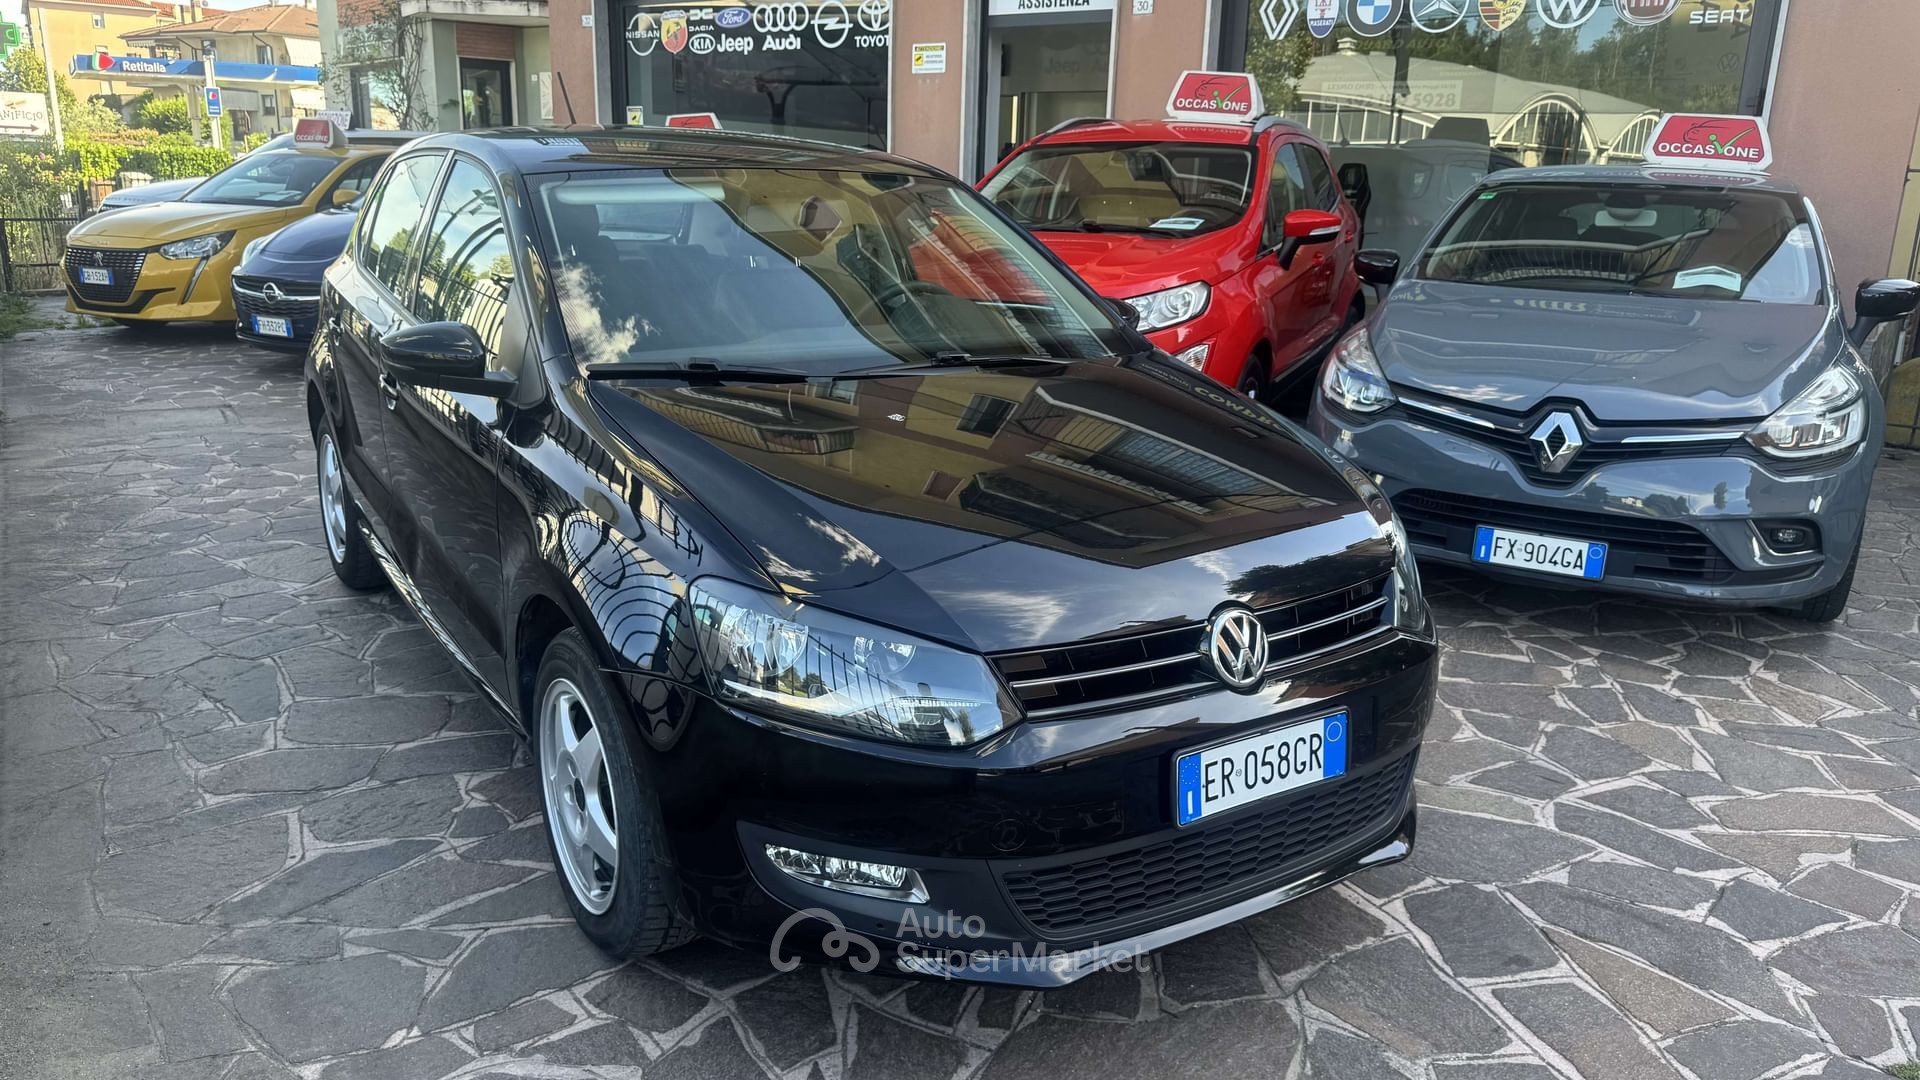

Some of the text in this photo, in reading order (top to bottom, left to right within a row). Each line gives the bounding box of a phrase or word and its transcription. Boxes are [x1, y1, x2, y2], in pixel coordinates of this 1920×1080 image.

[721, 10, 744, 24] Ford
[1689, 9, 1750, 24] SEAT
[625, 30, 660, 39] NISSAN
[693, 38, 711, 50] KIA
[717, 34, 754, 55] Jeep
[762, 34, 801, 51] Audi
[854, 35, 889, 48] TOYOT
[122, 60, 167, 73] Retitalia
